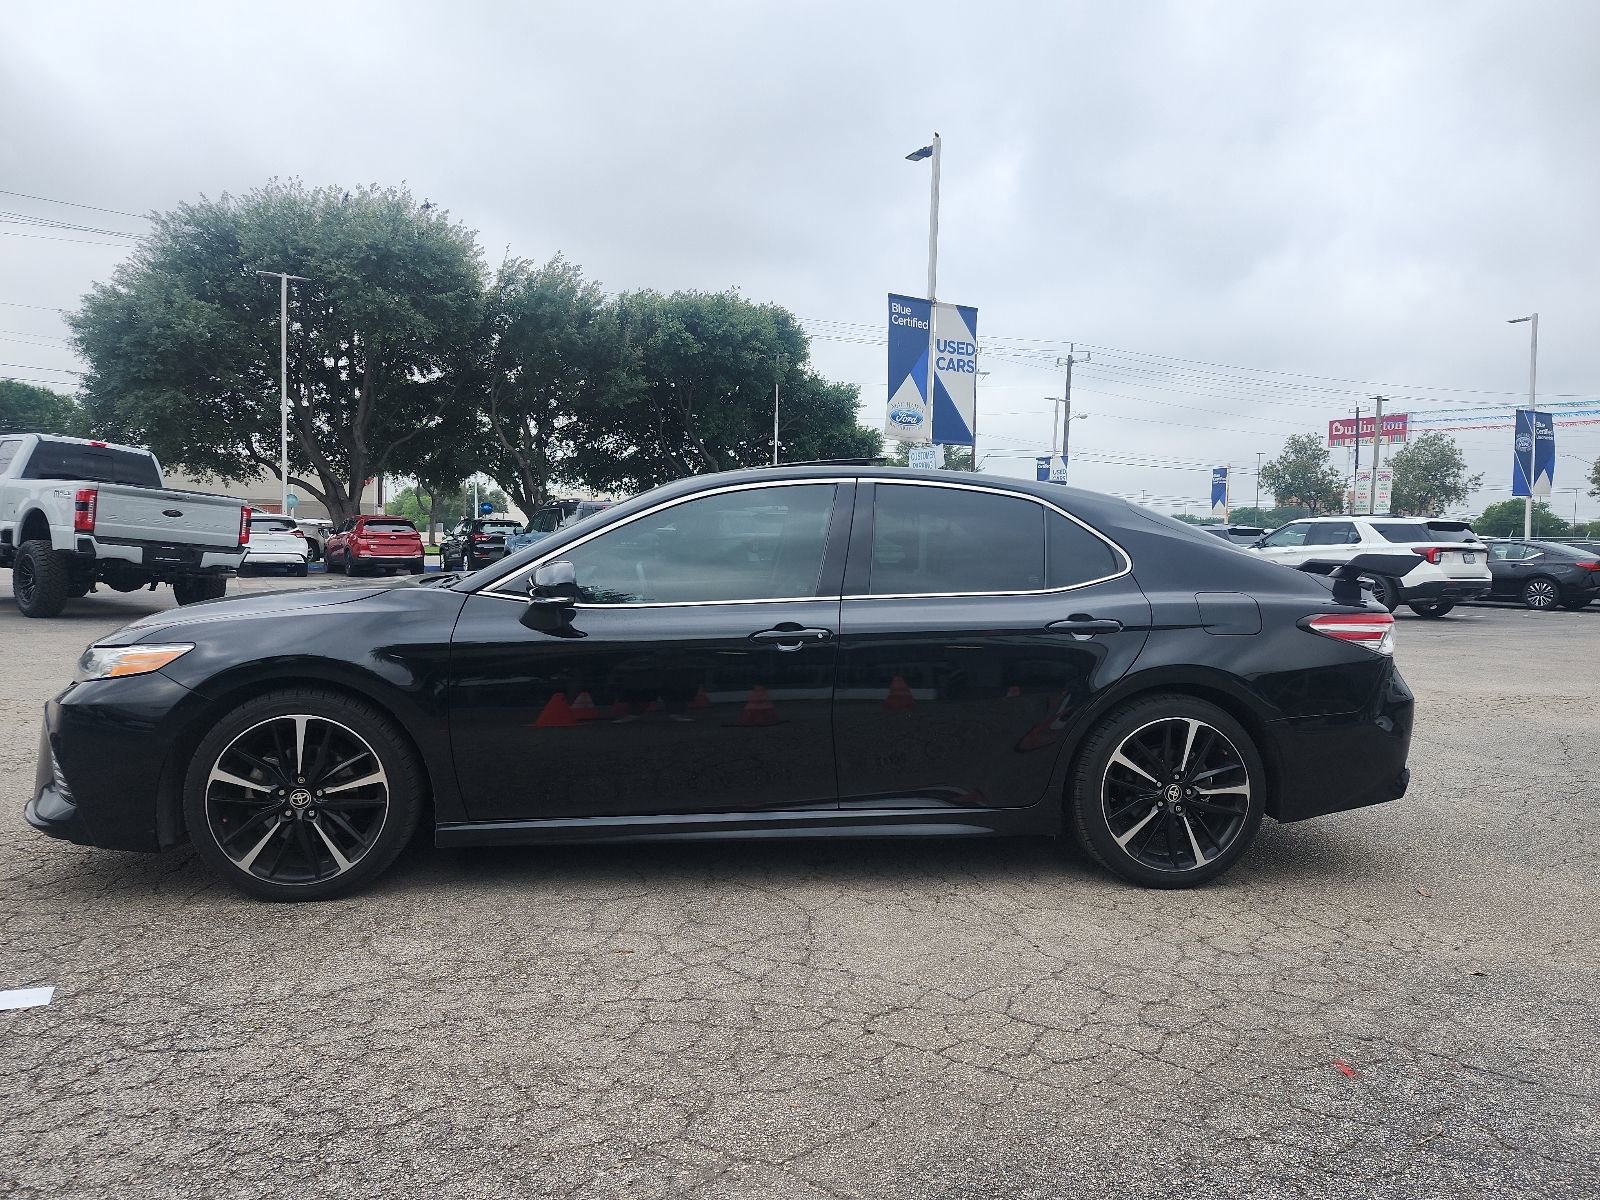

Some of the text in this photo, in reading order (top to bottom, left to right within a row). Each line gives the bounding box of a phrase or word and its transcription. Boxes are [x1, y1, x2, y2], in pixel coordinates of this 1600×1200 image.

[891, 302, 912, 315] Blue
[891, 314, 929, 330] Certified
[936, 338, 976, 356] USED
[936, 356, 975, 374] CARS
[895, 411, 919, 423] Ford
[911, 450, 936, 461] CUSTOMER
